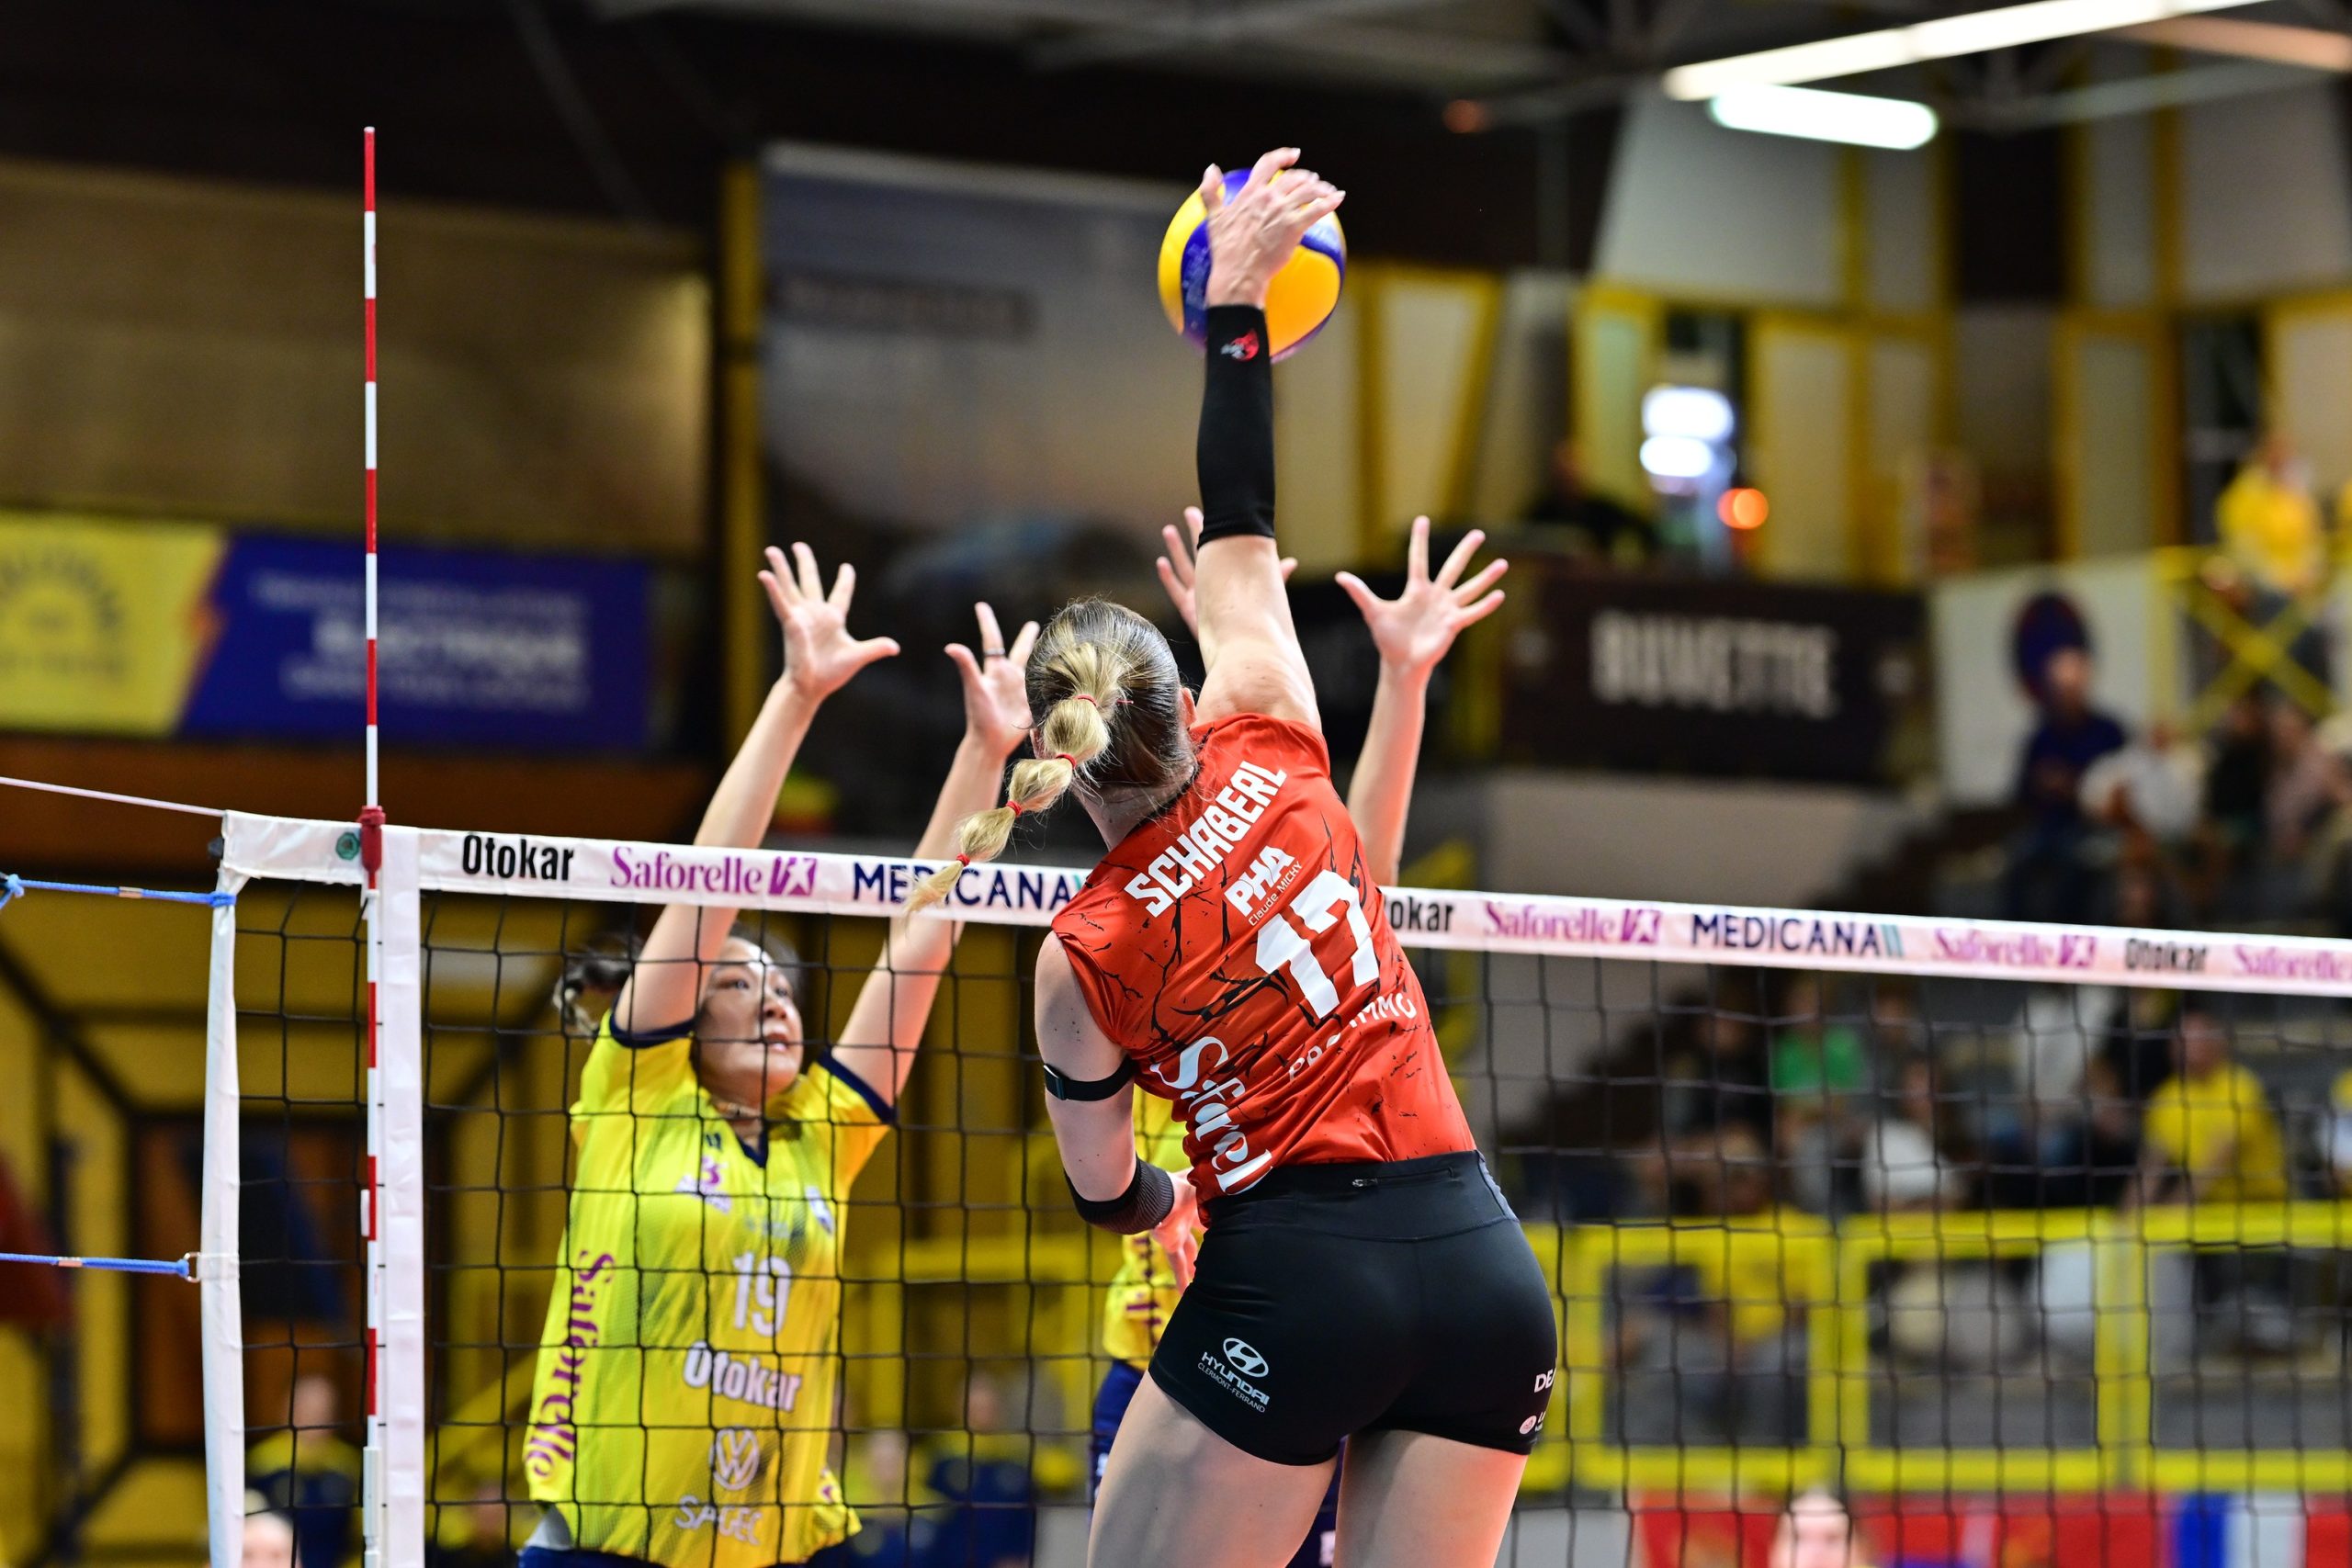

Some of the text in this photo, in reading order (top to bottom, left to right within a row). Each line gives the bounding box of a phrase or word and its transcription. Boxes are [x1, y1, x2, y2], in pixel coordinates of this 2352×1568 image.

[462, 835, 574, 882] Otokar
[1124, 761, 1287, 918] SCHABERL
[610, 846, 762, 895] Saforelle
[853, 862, 1071, 911] MECANA
[1224, 845, 1295, 917] PHA
[1248, 861, 1303, 926] Claude MICHY
[1384, 896, 1454, 931] okar
[1484, 901, 1617, 941] Saforelle
[1690, 914, 1881, 958] MEDICANA
[732, 1251, 792, 1337] 19
[683, 1340, 802, 1413] Otokar
[1197, 1362, 1266, 1413] CLERMONT-FERRAND
[1201, 1351, 1270, 1405] HYUNDAI
